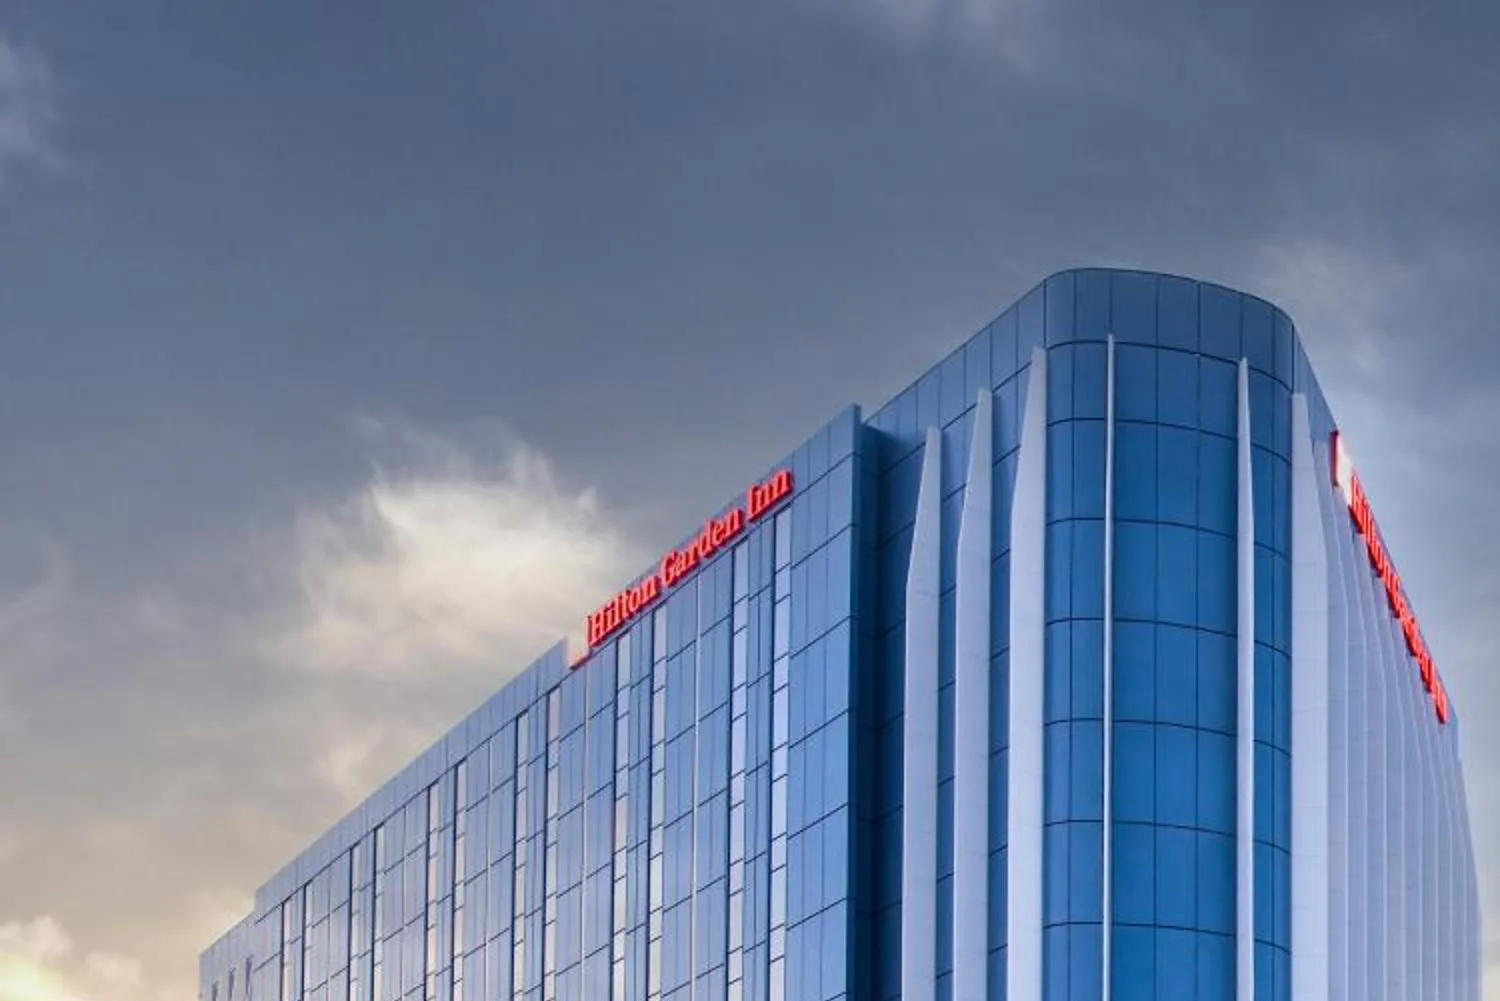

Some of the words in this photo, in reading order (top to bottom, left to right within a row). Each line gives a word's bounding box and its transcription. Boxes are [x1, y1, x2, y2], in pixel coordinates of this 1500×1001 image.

[585, 573, 661, 648] Hilton
[661, 508, 745, 587] Garden
[746, 468, 794, 523] Inn
